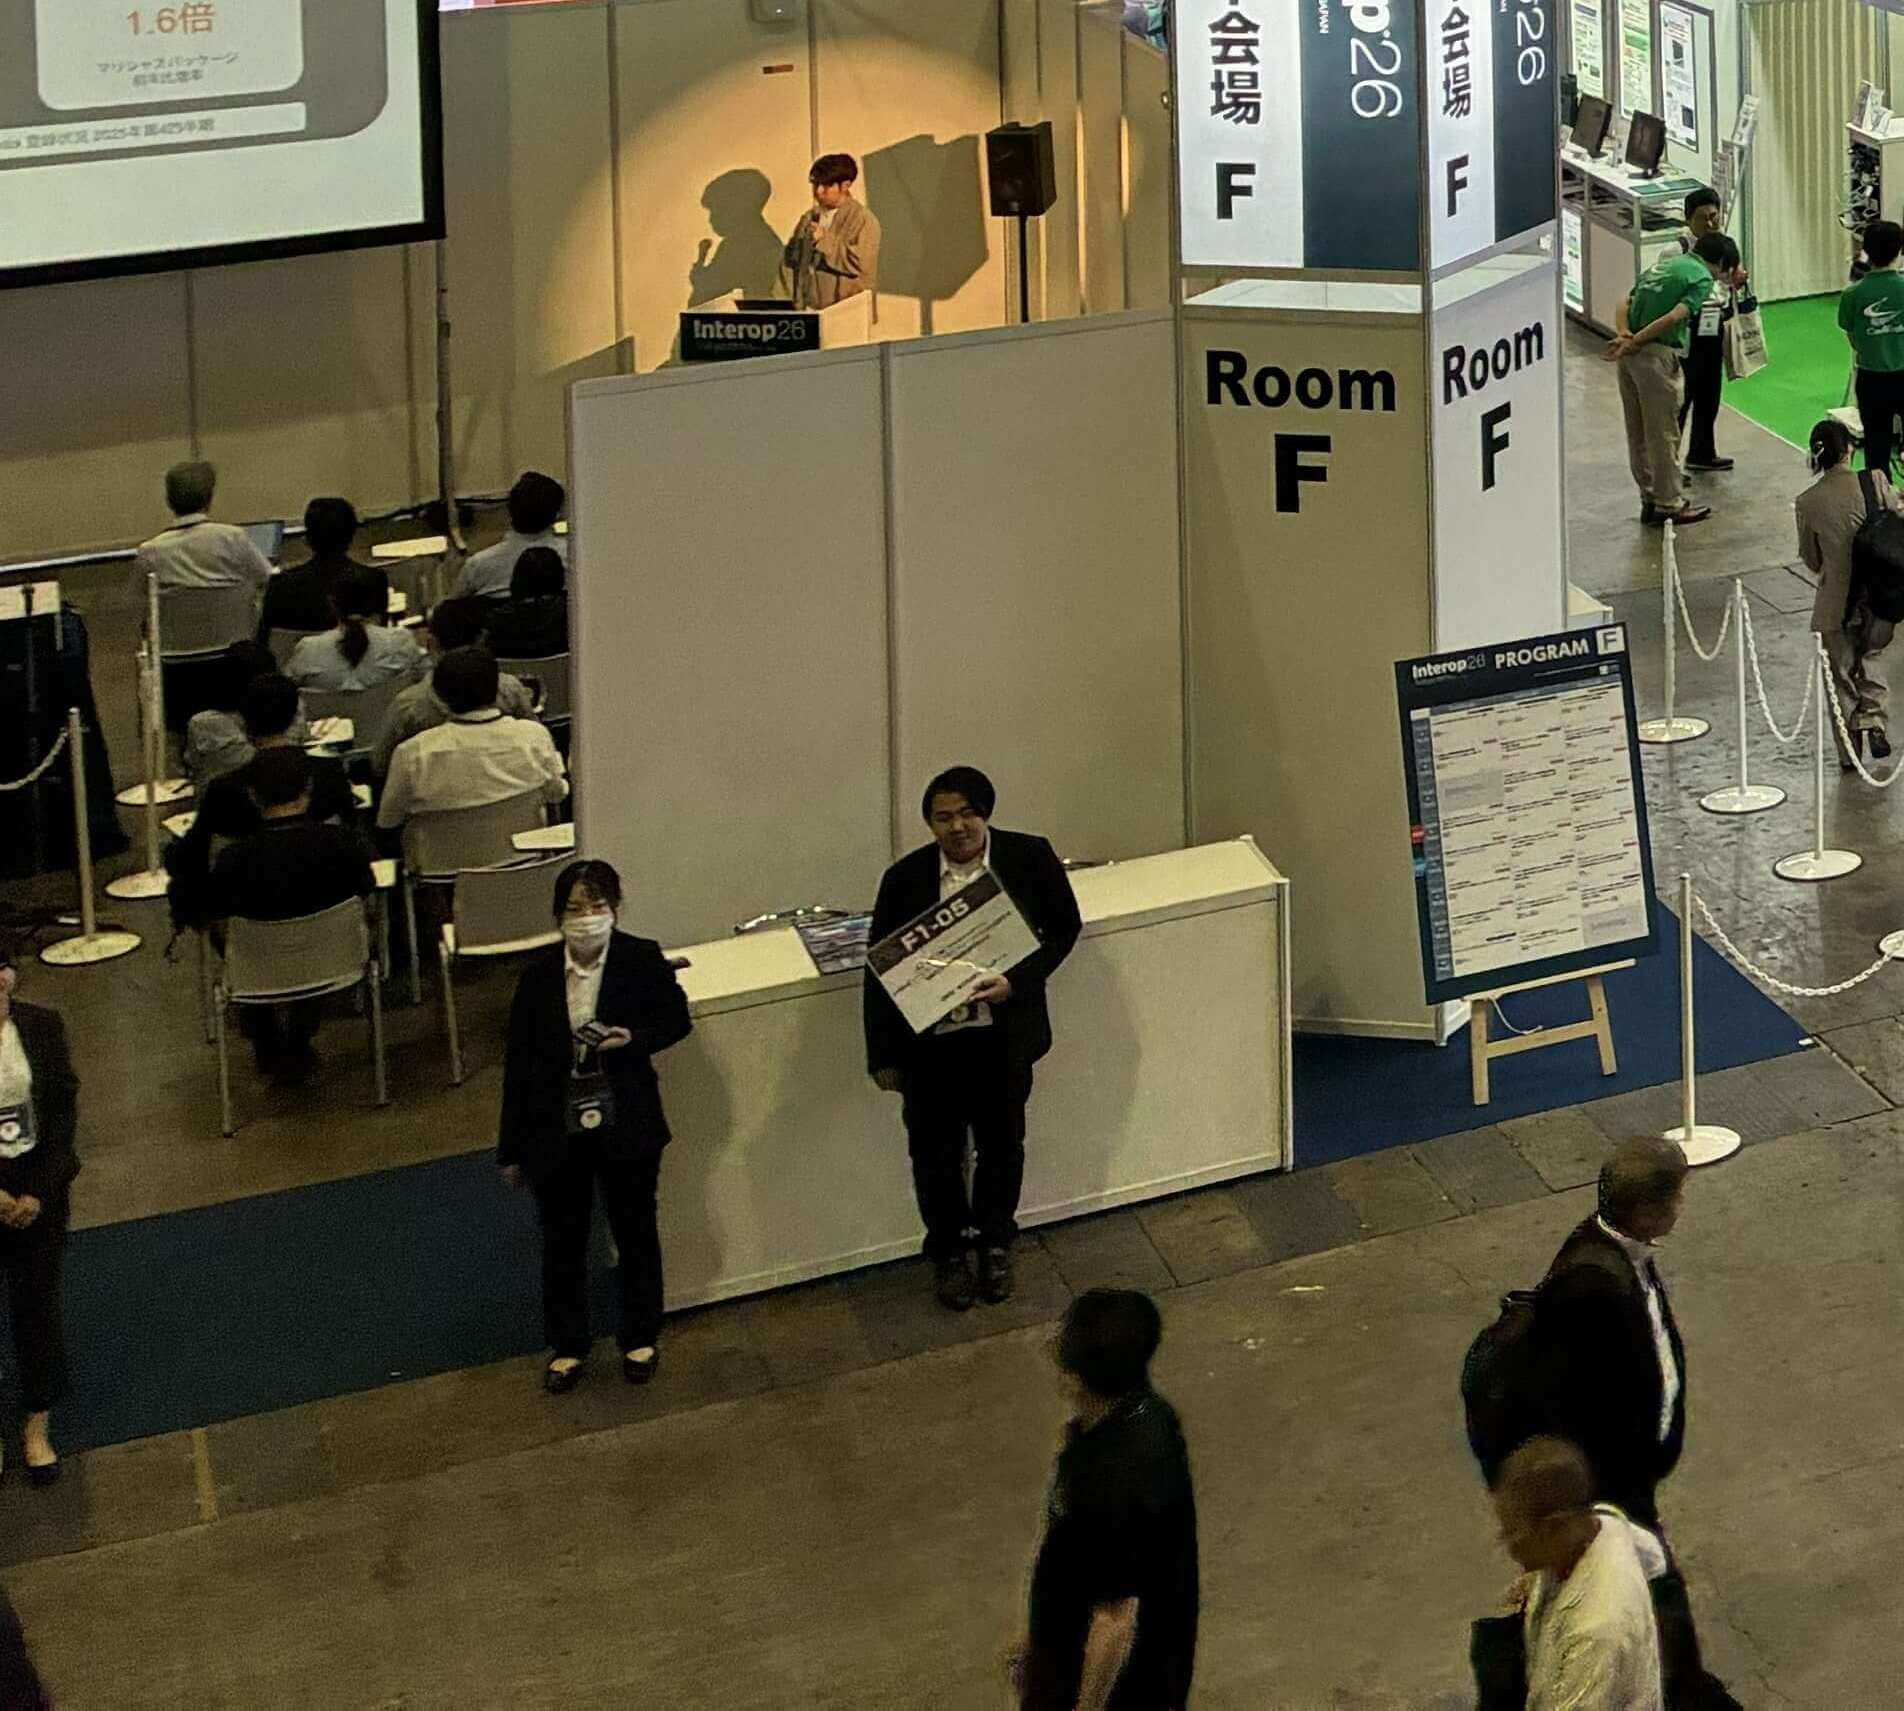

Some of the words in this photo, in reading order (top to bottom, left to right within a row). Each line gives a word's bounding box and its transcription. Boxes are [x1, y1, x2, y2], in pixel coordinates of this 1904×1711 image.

[126, 0, 216, 36] 1.6倍
[1215, 160, 1257, 221] F
[1446, 153, 1469, 218] F
[1203, 347, 1398, 413] Room
[1440, 319, 1546, 406] Room
[1272, 433, 1333, 515] F
[1480, 401, 1512, 492] F
[1494, 637, 1590, 670] PROGRAM
[1602, 629, 1621, 652] F
